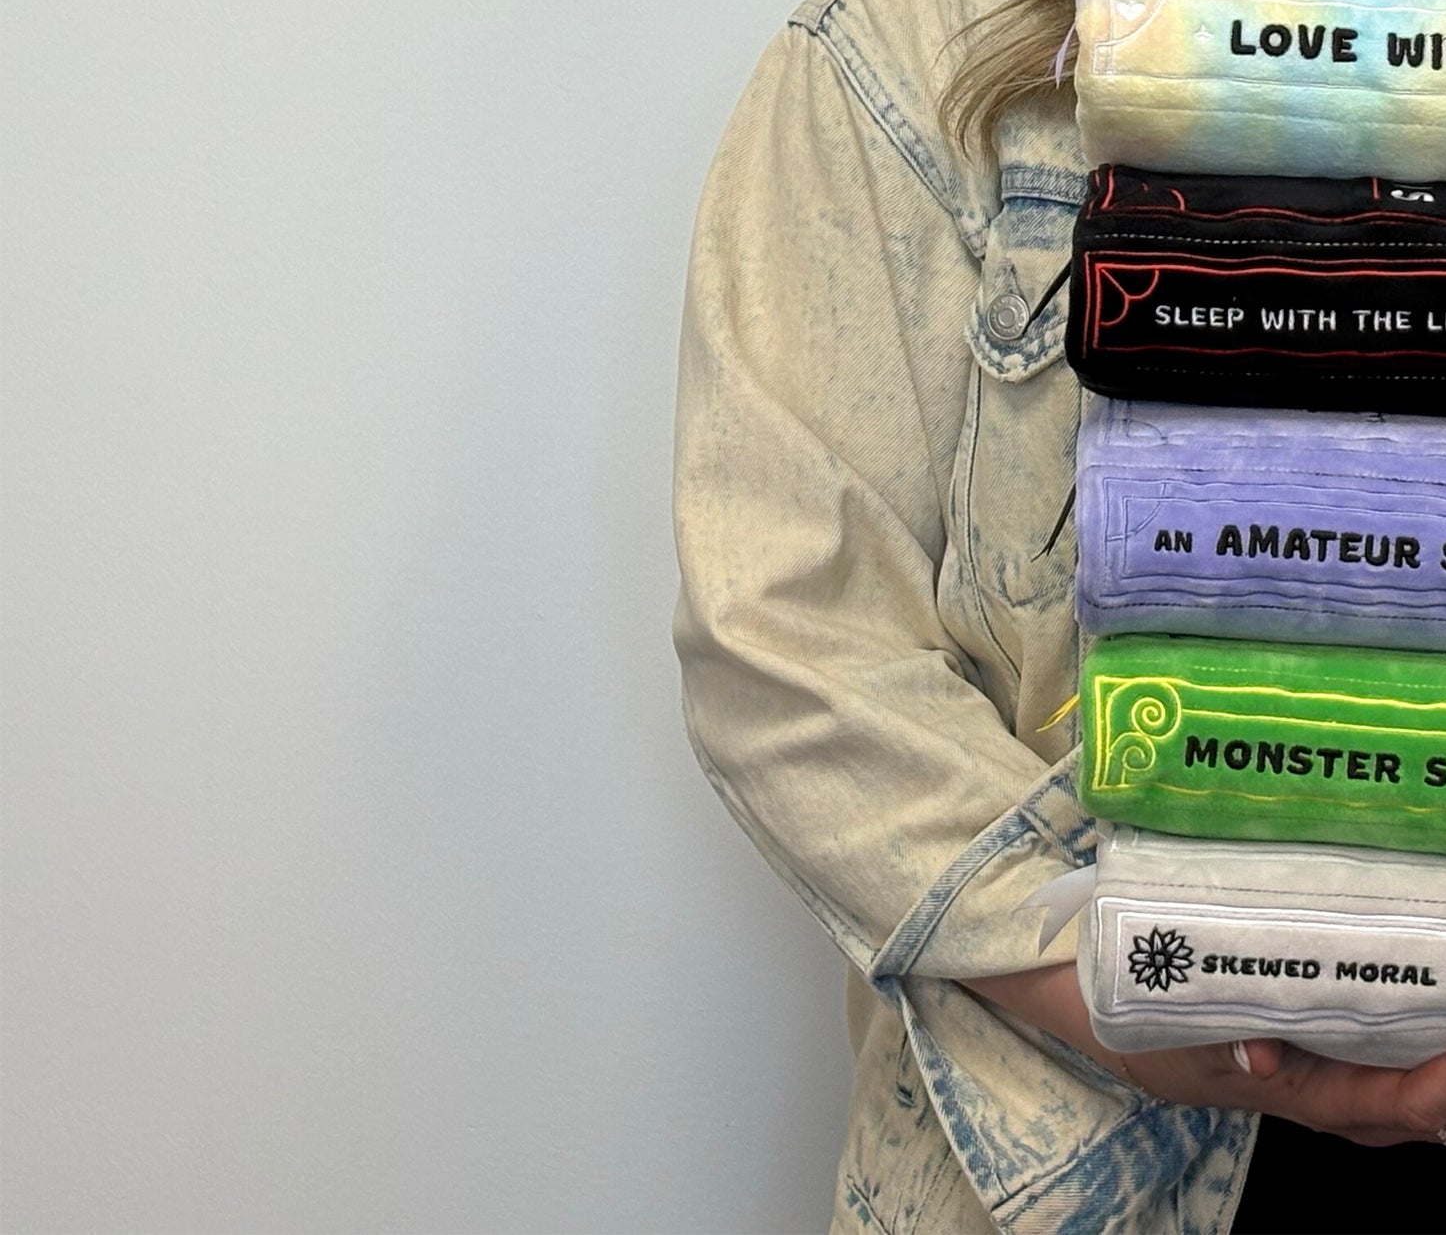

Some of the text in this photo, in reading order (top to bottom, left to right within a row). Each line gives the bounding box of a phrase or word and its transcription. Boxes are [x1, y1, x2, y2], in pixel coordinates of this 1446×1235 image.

[1230, 20, 1358, 63] LOVE
[1155, 305, 1244, 329] SLEEP
[1261, 308, 1336, 331] WITH
[1353, 309, 1411, 331] THE
[1154, 530, 1193, 553] AN
[1216, 524, 1421, 569] AMATEUR
[1185, 735, 1401, 784] MONSTER
[1201, 955, 1321, 980] SKEWED
[1335, 962, 1437, 987] MORAL
